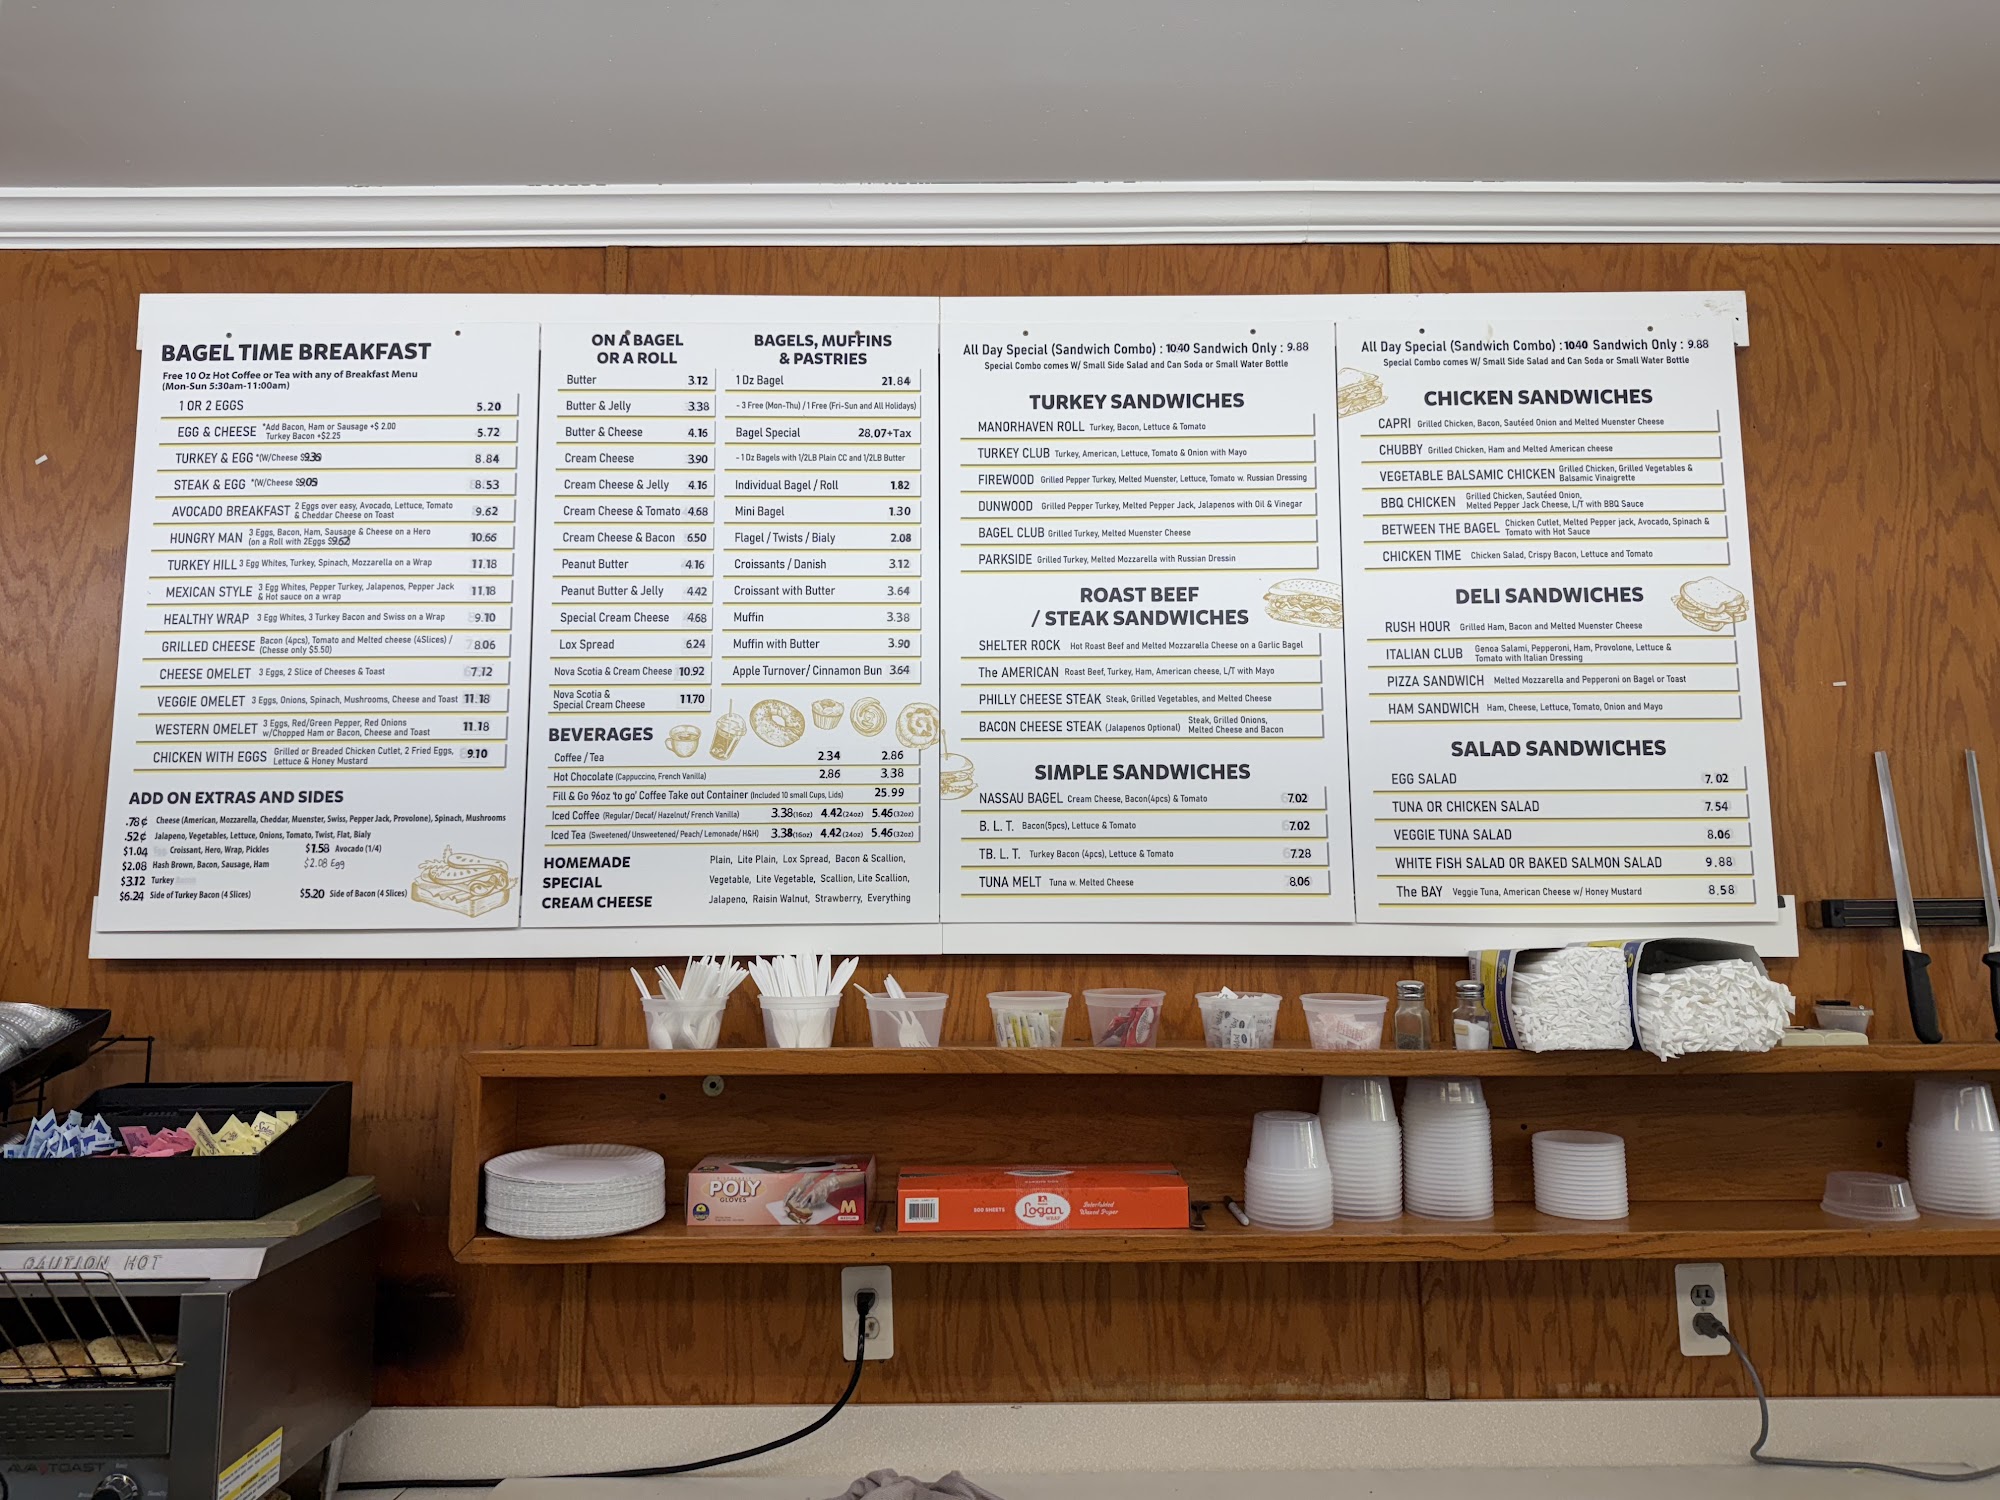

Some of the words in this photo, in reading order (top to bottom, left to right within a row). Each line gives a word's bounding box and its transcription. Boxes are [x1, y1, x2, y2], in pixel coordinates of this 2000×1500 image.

[592, 334, 615, 346] ON
[619, 334, 631, 346] A
[634, 334, 683, 346] BAGEL
[755, 335, 818, 349] BAGELS,
[822, 334, 892, 347] MUFFINS
[162, 344, 234, 361] BAGEL
[239, 344, 293, 361] TIME
[299, 343, 431, 360] BREAKFAST
[963, 344, 978, 355] All
[983, 344, 1002, 358] Day
[1007, 344, 1047, 358] Special
[1052, 343, 1109, 356] (Sandwich
[1114, 343, 1155, 355] Combo)
[1160, 346, 1162, 354] :
[1194, 343, 1247, 353] Sandwich
[1252, 342, 1276, 356] Only
[1280, 345, 1283, 353] :
[1287, 342, 1308, 351] 9.88
[597, 352, 619, 364] OR
[623, 352, 634, 364] A
[638, 352, 677, 364] ROLL
[780, 353, 790, 364] &
[794, 353, 867, 365] PASTRIES
[232, 371, 261, 379] Coffee
[334, 370, 344, 378] of
[346, 370, 389, 378] Breakfast
[392, 370, 417, 378] Menu
[567, 375, 596, 384] Butter
[688, 376, 708, 385] 3.12
[736, 375, 739, 384] 1
[743, 375, 754, 384] Dz
[757, 375, 783, 387] Bagel
[882, 377, 911, 385] 21.84
[163, 382, 206, 391] (Mon-Sun
[209, 382, 289, 390] 5:30am-11:00am)
[1029, 394, 1107, 409] TURKEY
[1111, 393, 1244, 409] SANDWICHES
[1424, 390, 1513, 406] CHICKEN
[1518, 389, 1652, 404] SANDWICHES
[979, 421, 1053, 432] MANORHAVEN
[1058, 421, 1085, 431] ROLL
[1379, 418, 1410, 428] CAPRI
[178, 427, 199, 437] EGG
[203, 427, 210, 437] &
[215, 426, 256, 437] CHEESE
[478, 428, 499, 437] 5.72
[736, 427, 763, 439] Bagel
[766, 427, 800, 439] Special
[858, 428, 911, 438] 28.07+Tax
[978, 448, 1019, 458] TURKEY
[1023, 448, 1050, 458] CLUB
[1380, 444, 1422, 455] CHUBBY
[176, 453, 217, 463] TURKEY
[221, 453, 228, 463] &
[232, 453, 253, 463] EGG
[475, 454, 499, 463] 8.84
[979, 474, 1034, 485] FIREWOOD
[979, 501, 1032, 511] DUNWOOD
[1381, 497, 1404, 508] BBQ
[1408, 497, 1455, 508] CHICKEN
[170, 533, 214, 543] HUNGRY
[218, 532, 242, 543] MAN
[472, 533, 497, 542] 10.66
[979, 554, 1032, 564] PARKSIDE
[1383, 550, 1431, 561] CHICKEN
[1435, 550, 1461, 560] TIME
[166, 587, 213, 597] MEXICAN
[219, 586, 252, 597] STYLE
[1081, 587, 1146, 602] ROAST
[1151, 587, 1199, 602] BEEF
[1456, 588, 1500, 604] DELI
[1505, 587, 1643, 603] SANDWICHES
[734, 612, 763, 622] Muffin
[1031, 610, 1040, 627] /
[1045, 611, 1109, 626] STEAK
[1113, 610, 1248, 625] SANDWICHES
[560, 639, 577, 649] Lox
[580, 639, 614, 651] Spread
[979, 640, 1027, 650] SHELTER
[1032, 640, 1060, 650] ROCK
[1387, 648, 1429, 659] ITALIAN
[1434, 648, 1462, 659] CLUB
[158, 696, 197, 707] VEGGIE
[201, 696, 245, 707] OMELET
[464, 694, 490, 703] 11.18
[549, 727, 653, 741] BEVERAGES
[1451, 741, 1521, 756] SALAD
[1526, 740, 1666, 756] SANDWICHES
[555, 753, 581, 762] Coffee
[584, 752, 588, 763] /
[590, 753, 604, 761] Tea
[818, 751, 840, 761] 2.34
[882, 751, 903, 760] 2.86
[1035, 765, 1108, 780] SIMPLE
[1113, 764, 1250, 780] SANDWICHES
[1392, 773, 1414, 784] EGG
[1419, 773, 1456, 784] SALAD
[1705, 774, 1728, 783] 7.02
[129, 792, 163, 804] ADD
[167, 792, 191, 804] ON
[195, 791, 256, 804] EXTRAS
[259, 791, 294, 803] AND
[298, 791, 343, 803] SIDES
[544, 857, 630, 868] HOMEMADE
[1395, 858, 1432, 868] WHITE
[1436, 858, 1461, 868] FISH
[1466, 857, 1504, 868] SALAD
[1509, 857, 1524, 868] OR
[1529, 857, 1567, 868] BAKED
[1572, 857, 1619, 868] SALMON
[1624, 857, 1661, 868] SALAD
[1706, 857, 1732, 867] 9.88
[543, 877, 602, 888] SPECIAL
[300, 888, 325, 898] $5.20
[377, 889, 384, 898] (4
[386, 889, 407, 898] Slices)
[542, 897, 593, 909] CREAM
[597, 896, 652, 908] CHEESE
[709, 895, 747, 905] Jalapeno,
[753, 895, 777, 903] Raisin
[780, 894, 810, 903] Walnut,
[815, 894, 862, 904] Strawberry,
[868, 894, 910, 904] Everything
[709, 1179, 762, 1197] POLY
[840, 1199, 857, 1214] M
[1022, 1201, 1064, 1218] Logan
[1101, 1208, 1119, 1217] Paper
[23, 1255, 110, 1270] CAUTION
[124, 1254, 163, 1271] HOT
